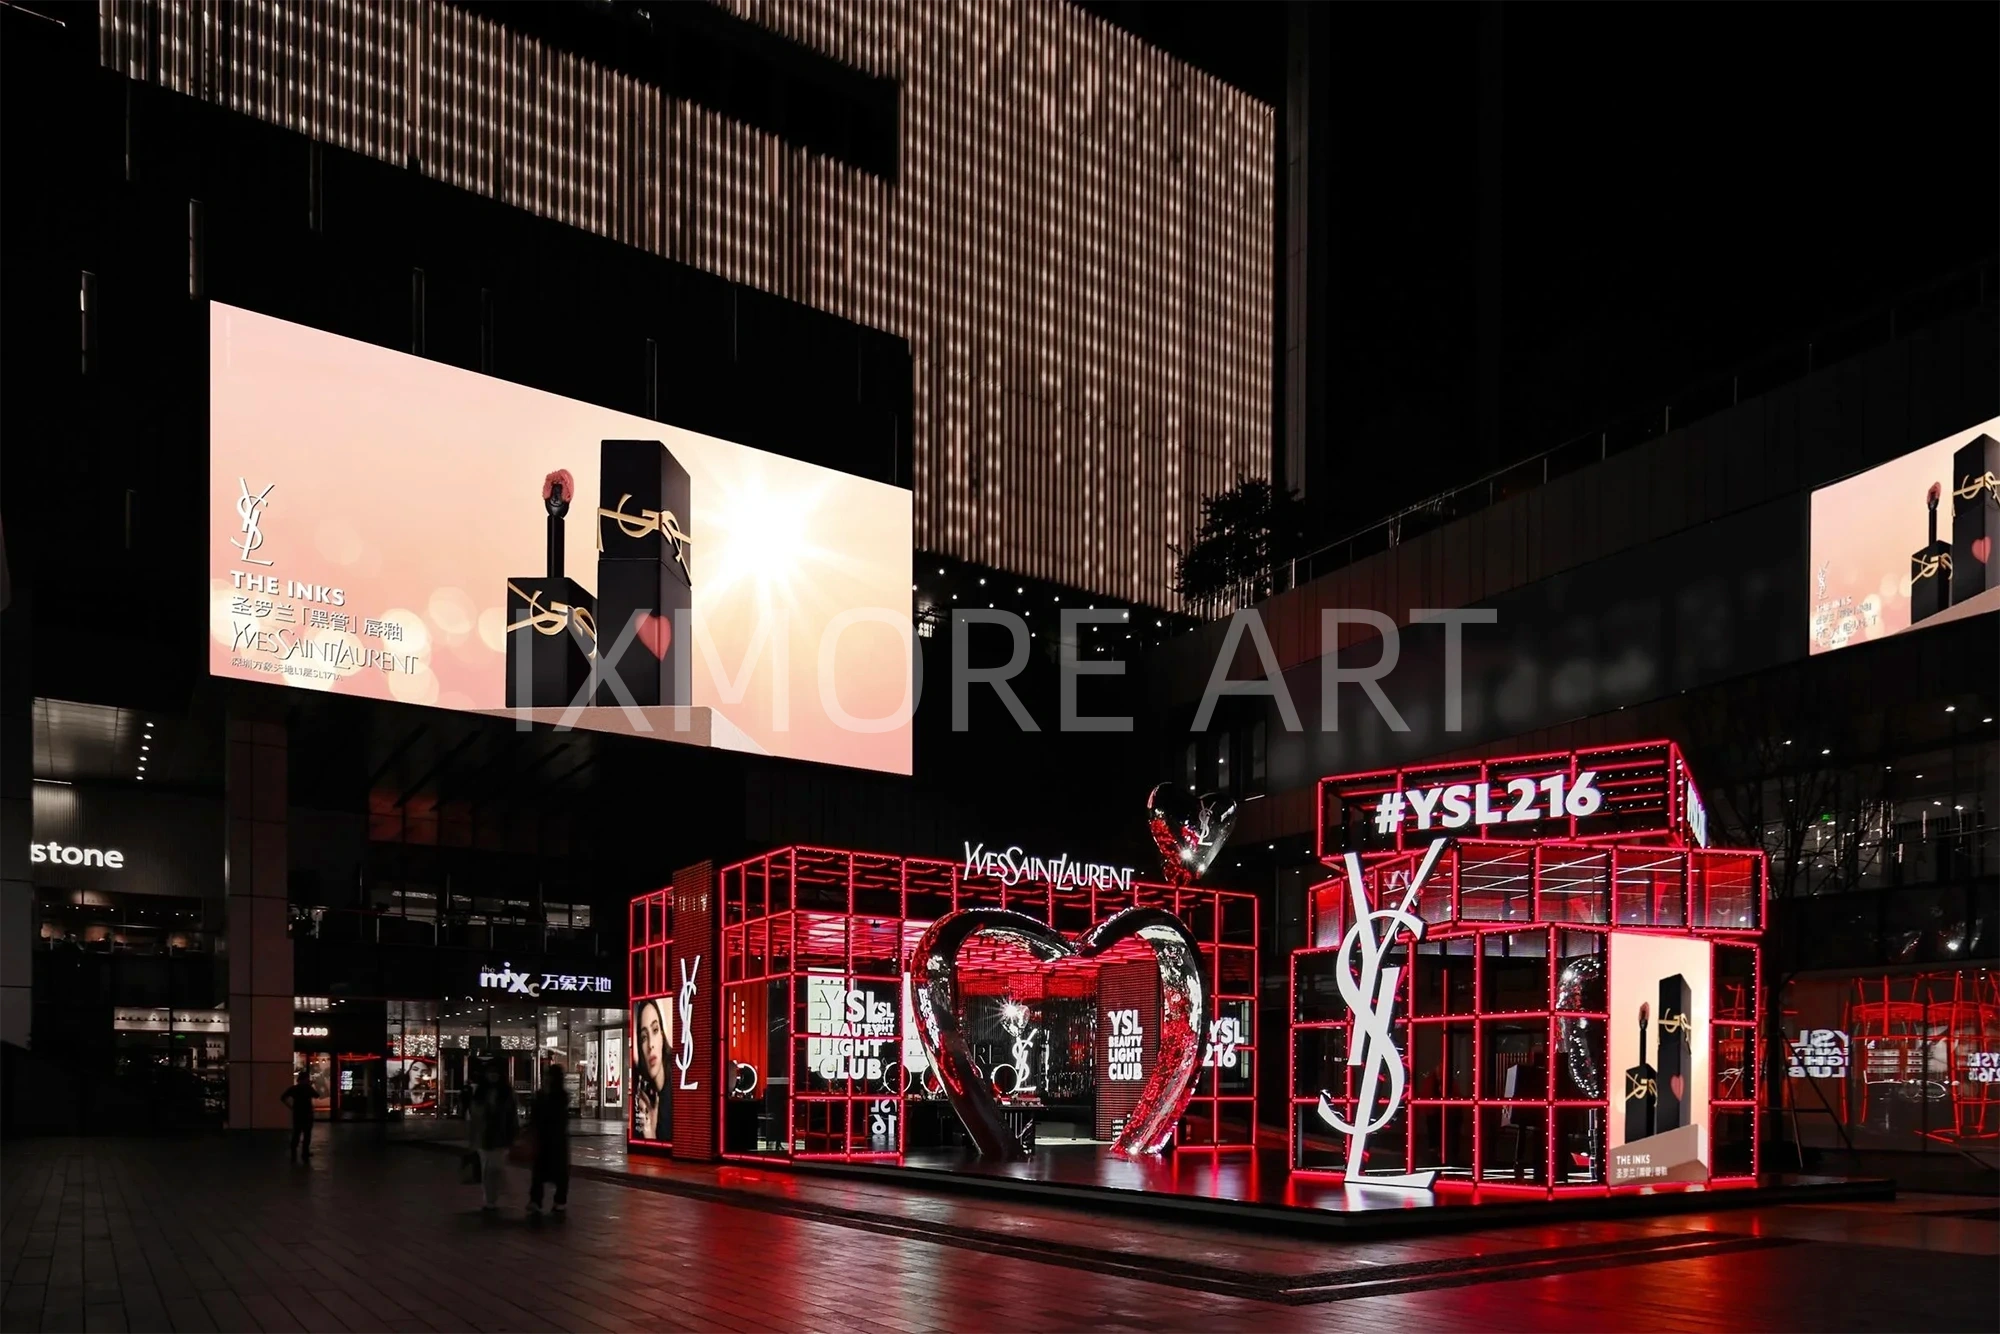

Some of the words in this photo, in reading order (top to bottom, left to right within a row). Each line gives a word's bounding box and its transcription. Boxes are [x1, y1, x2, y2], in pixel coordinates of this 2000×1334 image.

[230, 570, 280, 595] THE
[288, 581, 345, 606] INKS
[1375, 772, 1602, 834] #YSL216
[541, 974, 612, 993] 万象天地
[1107, 1010, 1143, 1036] YSL
[1210, 1019, 1245, 1045] YSL
[1108, 1036, 1142, 1048] BEAUTY
[1108, 1048, 1143, 1063] LIGHT
[1202, 1043, 1236, 1068] 216
[820, 1058, 882, 1080] CLUB
[1108, 1063, 1143, 1080] CLUB
[1616, 1155, 1631, 1165] THE
[1632, 1154, 1651, 1164] INKS
